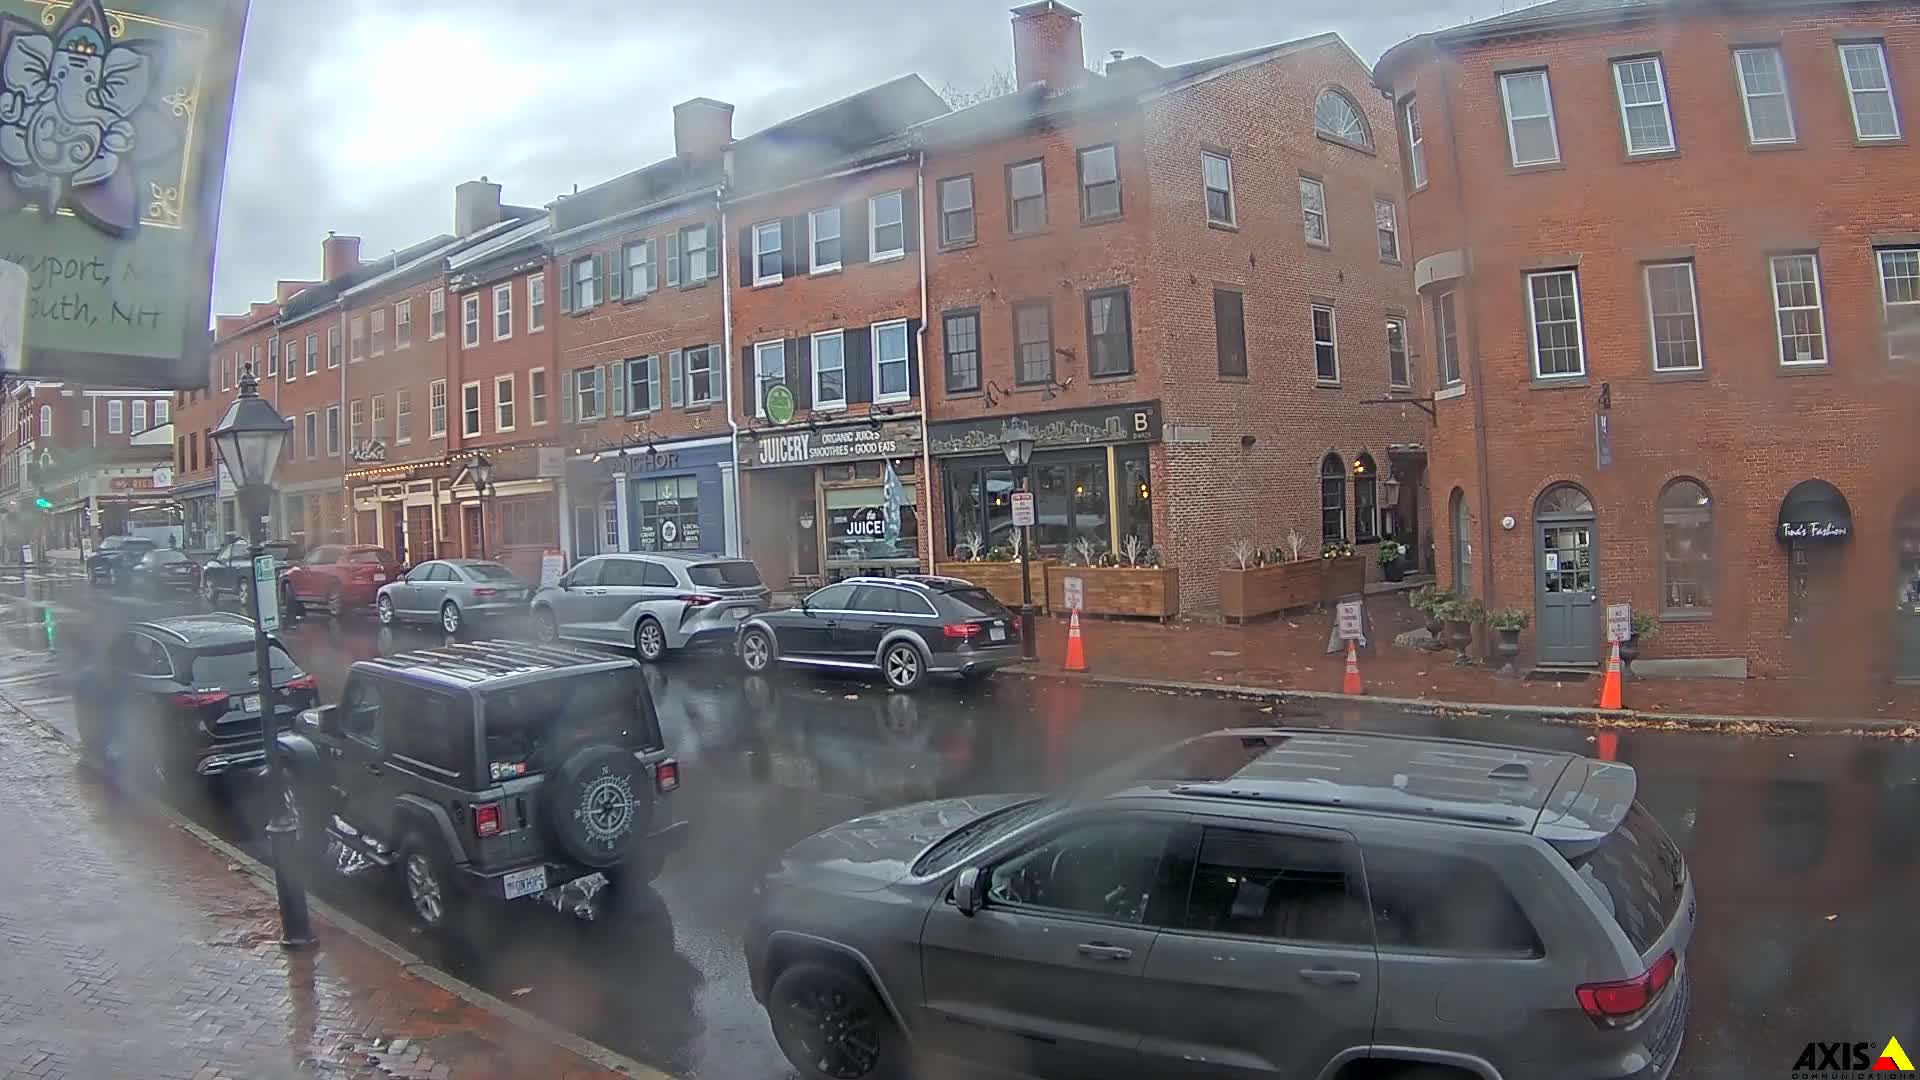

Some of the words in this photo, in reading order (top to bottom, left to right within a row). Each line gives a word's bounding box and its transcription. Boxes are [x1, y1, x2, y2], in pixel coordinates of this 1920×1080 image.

[1134, 412, 1148, 432] B
[821, 431, 854, 445] ORGANIC
[854, 430, 881, 442] JUICES
[759, 434, 811, 465] JUICERY
[808, 445, 850, 459] SMOOTHIES
[854, 442, 878, 455] GOOD
[878, 440, 897, 453] EATS
